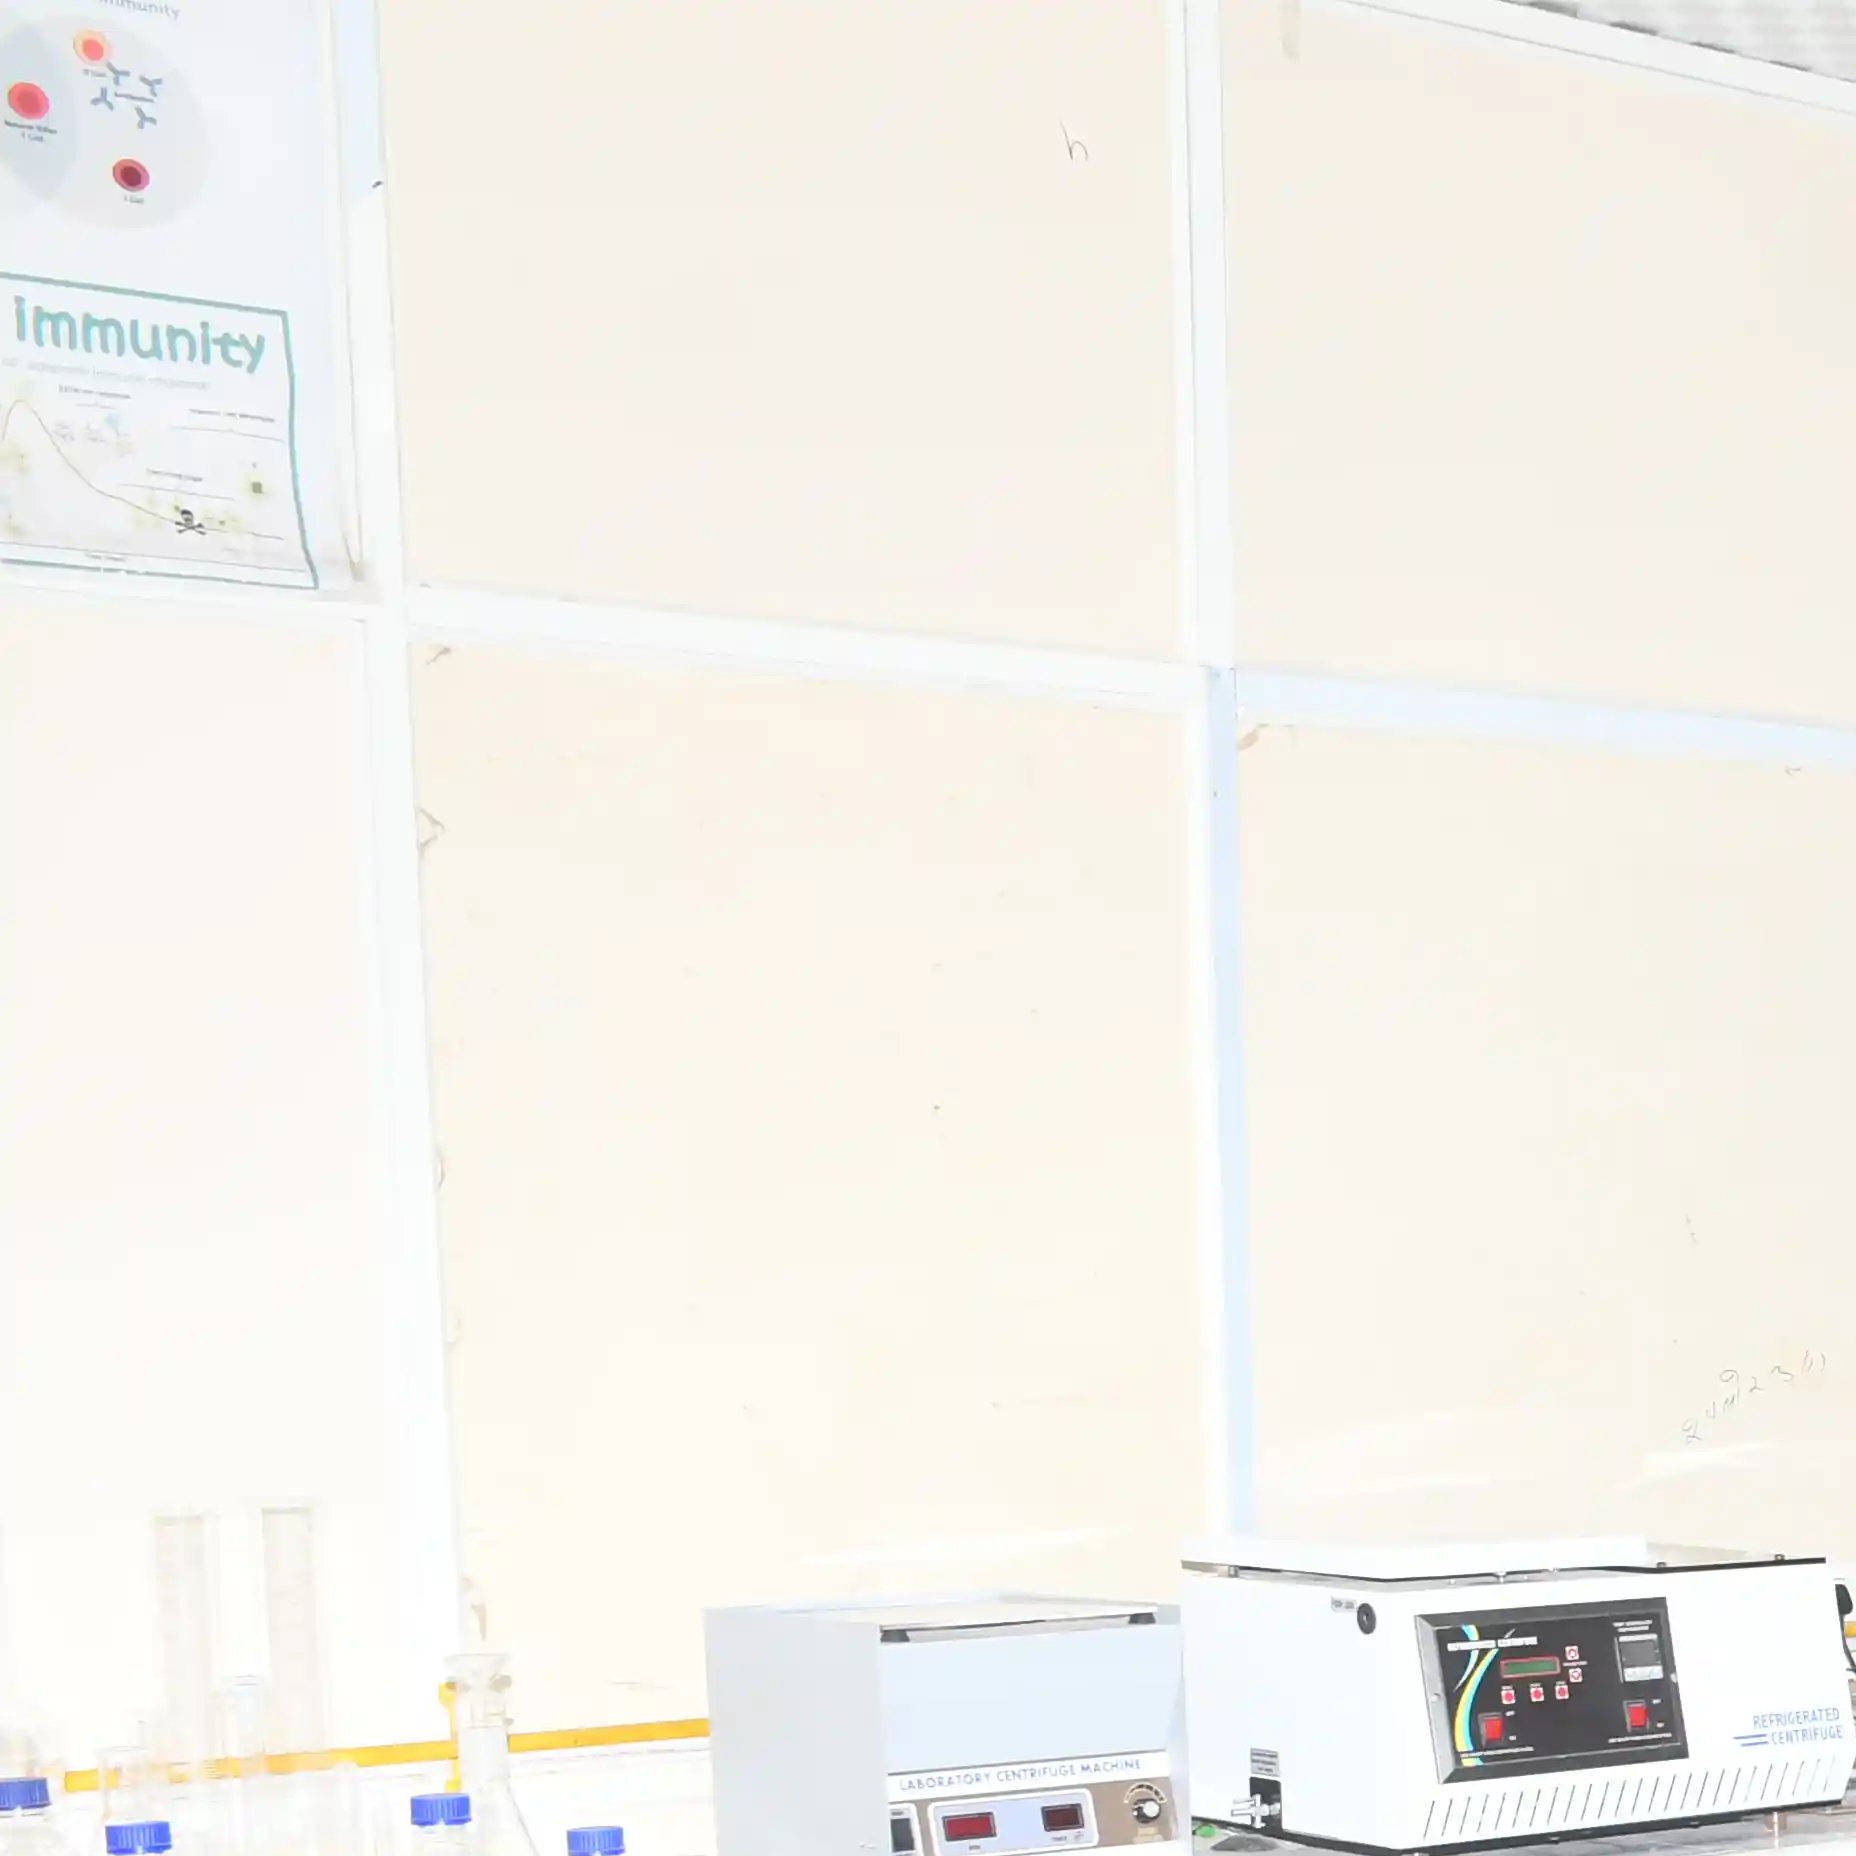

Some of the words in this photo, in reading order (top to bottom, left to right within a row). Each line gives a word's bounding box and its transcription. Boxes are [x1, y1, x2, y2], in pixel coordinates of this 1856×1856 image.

[14, 295, 266, 374] Immunity
[1752, 1707, 1840, 1730] REFRIGERATED
[1771, 1724, 1843, 1745] CENTRIFUGE
[899, 1772, 990, 1792] LABORATORY
[996, 1763, 1076, 1783] CENTRIFUGE
[1080, 1757, 1142, 1774] MACHINE
